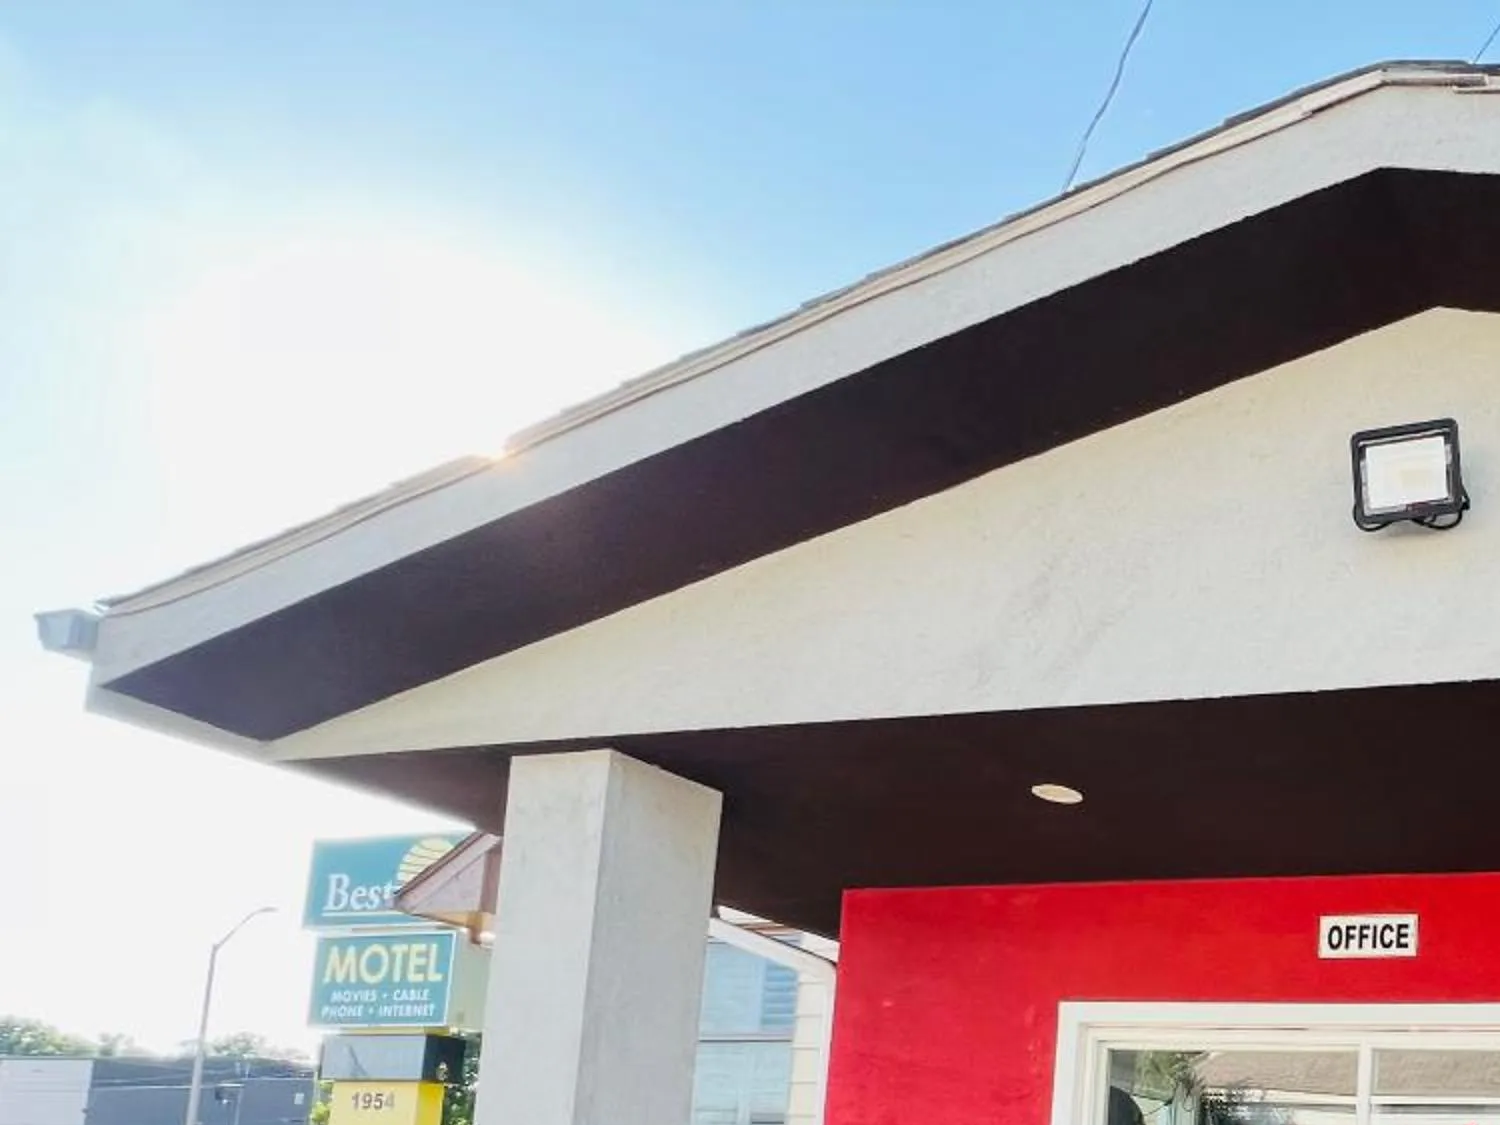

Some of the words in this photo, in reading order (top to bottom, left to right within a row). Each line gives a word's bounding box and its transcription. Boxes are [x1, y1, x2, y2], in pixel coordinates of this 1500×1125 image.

[322, 873, 402, 911] Best
[1327, 923, 1409, 950] OFFICE
[323, 944, 443, 984] MOTEL
[331, 989, 377, 1002] MOVIES
[393, 988, 430, 1001] CABLE
[321, 1004, 363, 1017] PHONE
[379, 1004, 435, 1017] INTERNET
[351, 1092, 395, 1111] 1954
